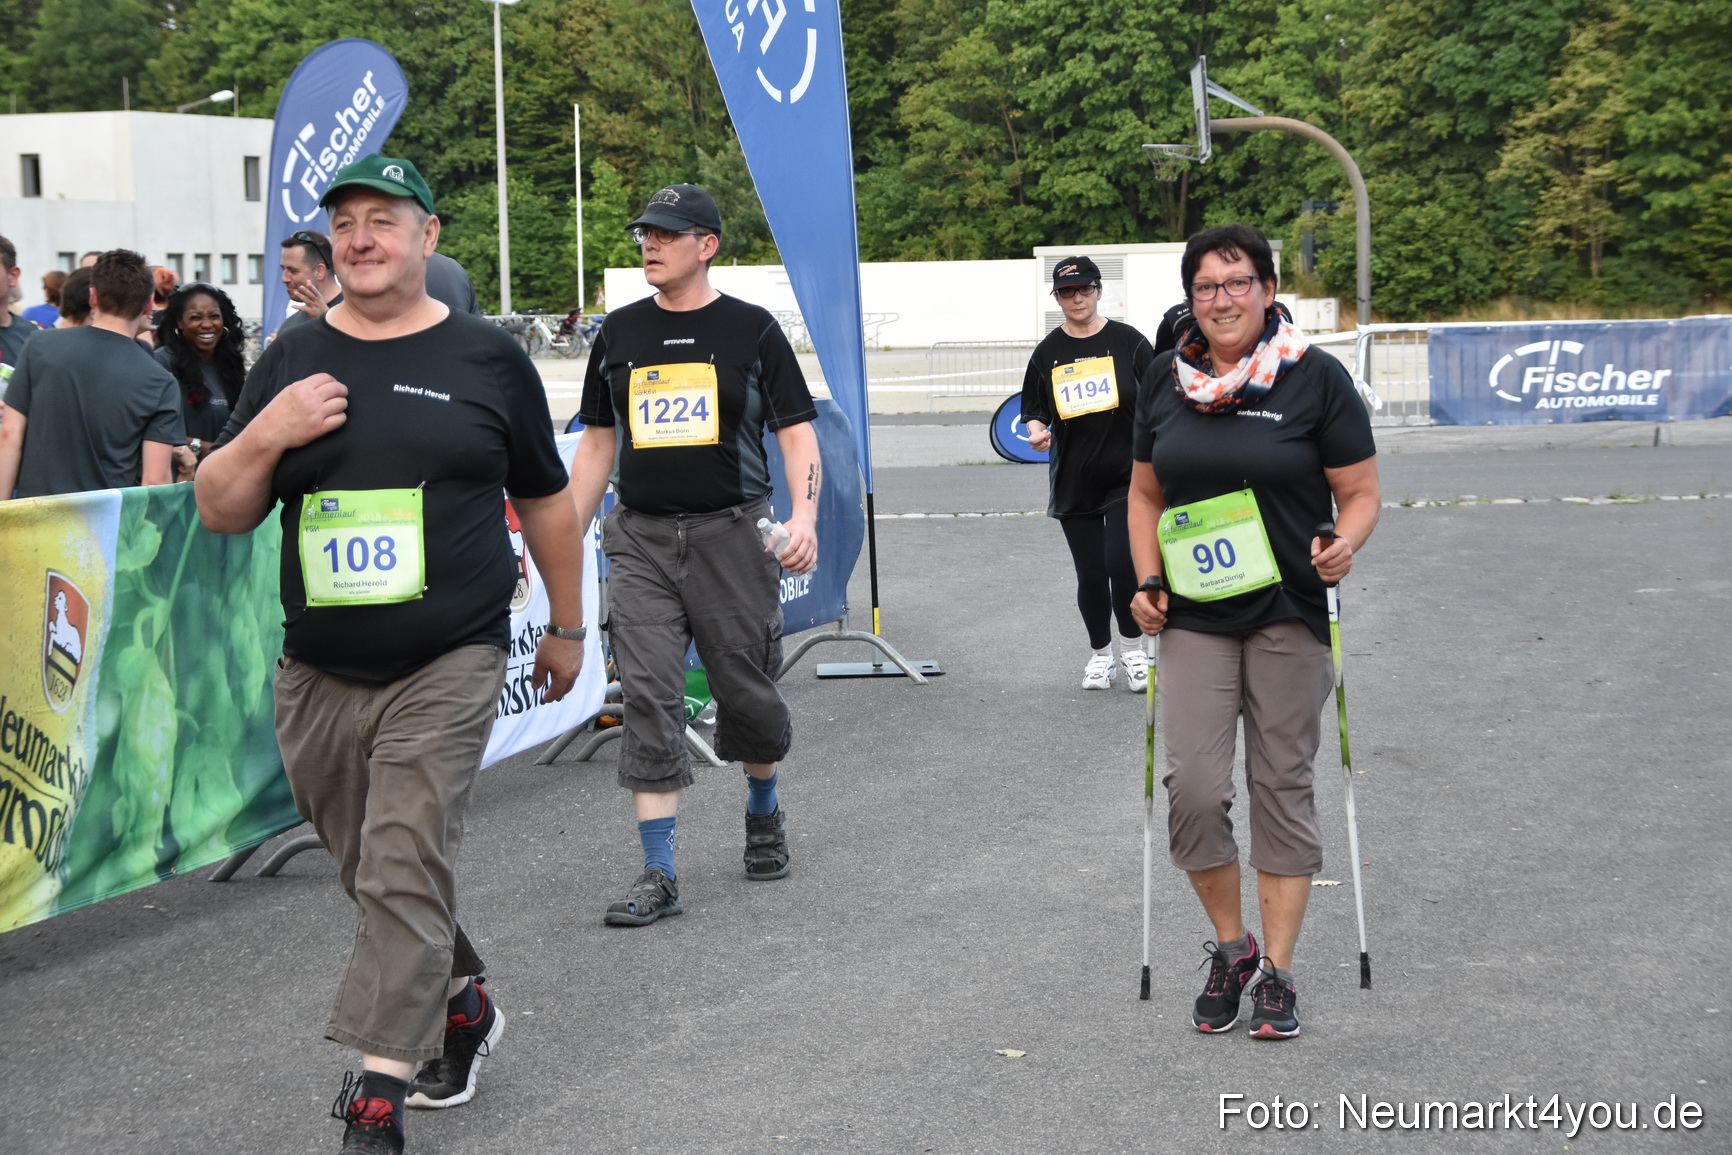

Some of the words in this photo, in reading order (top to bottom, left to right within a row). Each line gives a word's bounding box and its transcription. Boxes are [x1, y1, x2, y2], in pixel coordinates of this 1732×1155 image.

[300, 70, 377, 201] Fischer
[1061, 377, 1111, 403] 1194
[1521, 364, 1673, 394] Fischer
[393, 383, 423, 395] Richard
[424, 388, 451, 401] Herold
[1534, 394, 1660, 410] AUTOMOBILE
[638, 395, 710, 425] 1224
[1262, 410, 1283, 421] Dirrigl
[655, 428, 675, 436] Markus
[314, 508, 357, 520] firmenlauf
[323, 535, 397, 573] 108
[1192, 537, 1236, 574] 90
[333, 580, 361, 589] Richard
[361, 579, 388, 587] Herold
[1199, 578, 1225, 588] Barbara
[1224, 572, 1246, 583] Dirrigl
[48, 673, 70, 703] 1628
